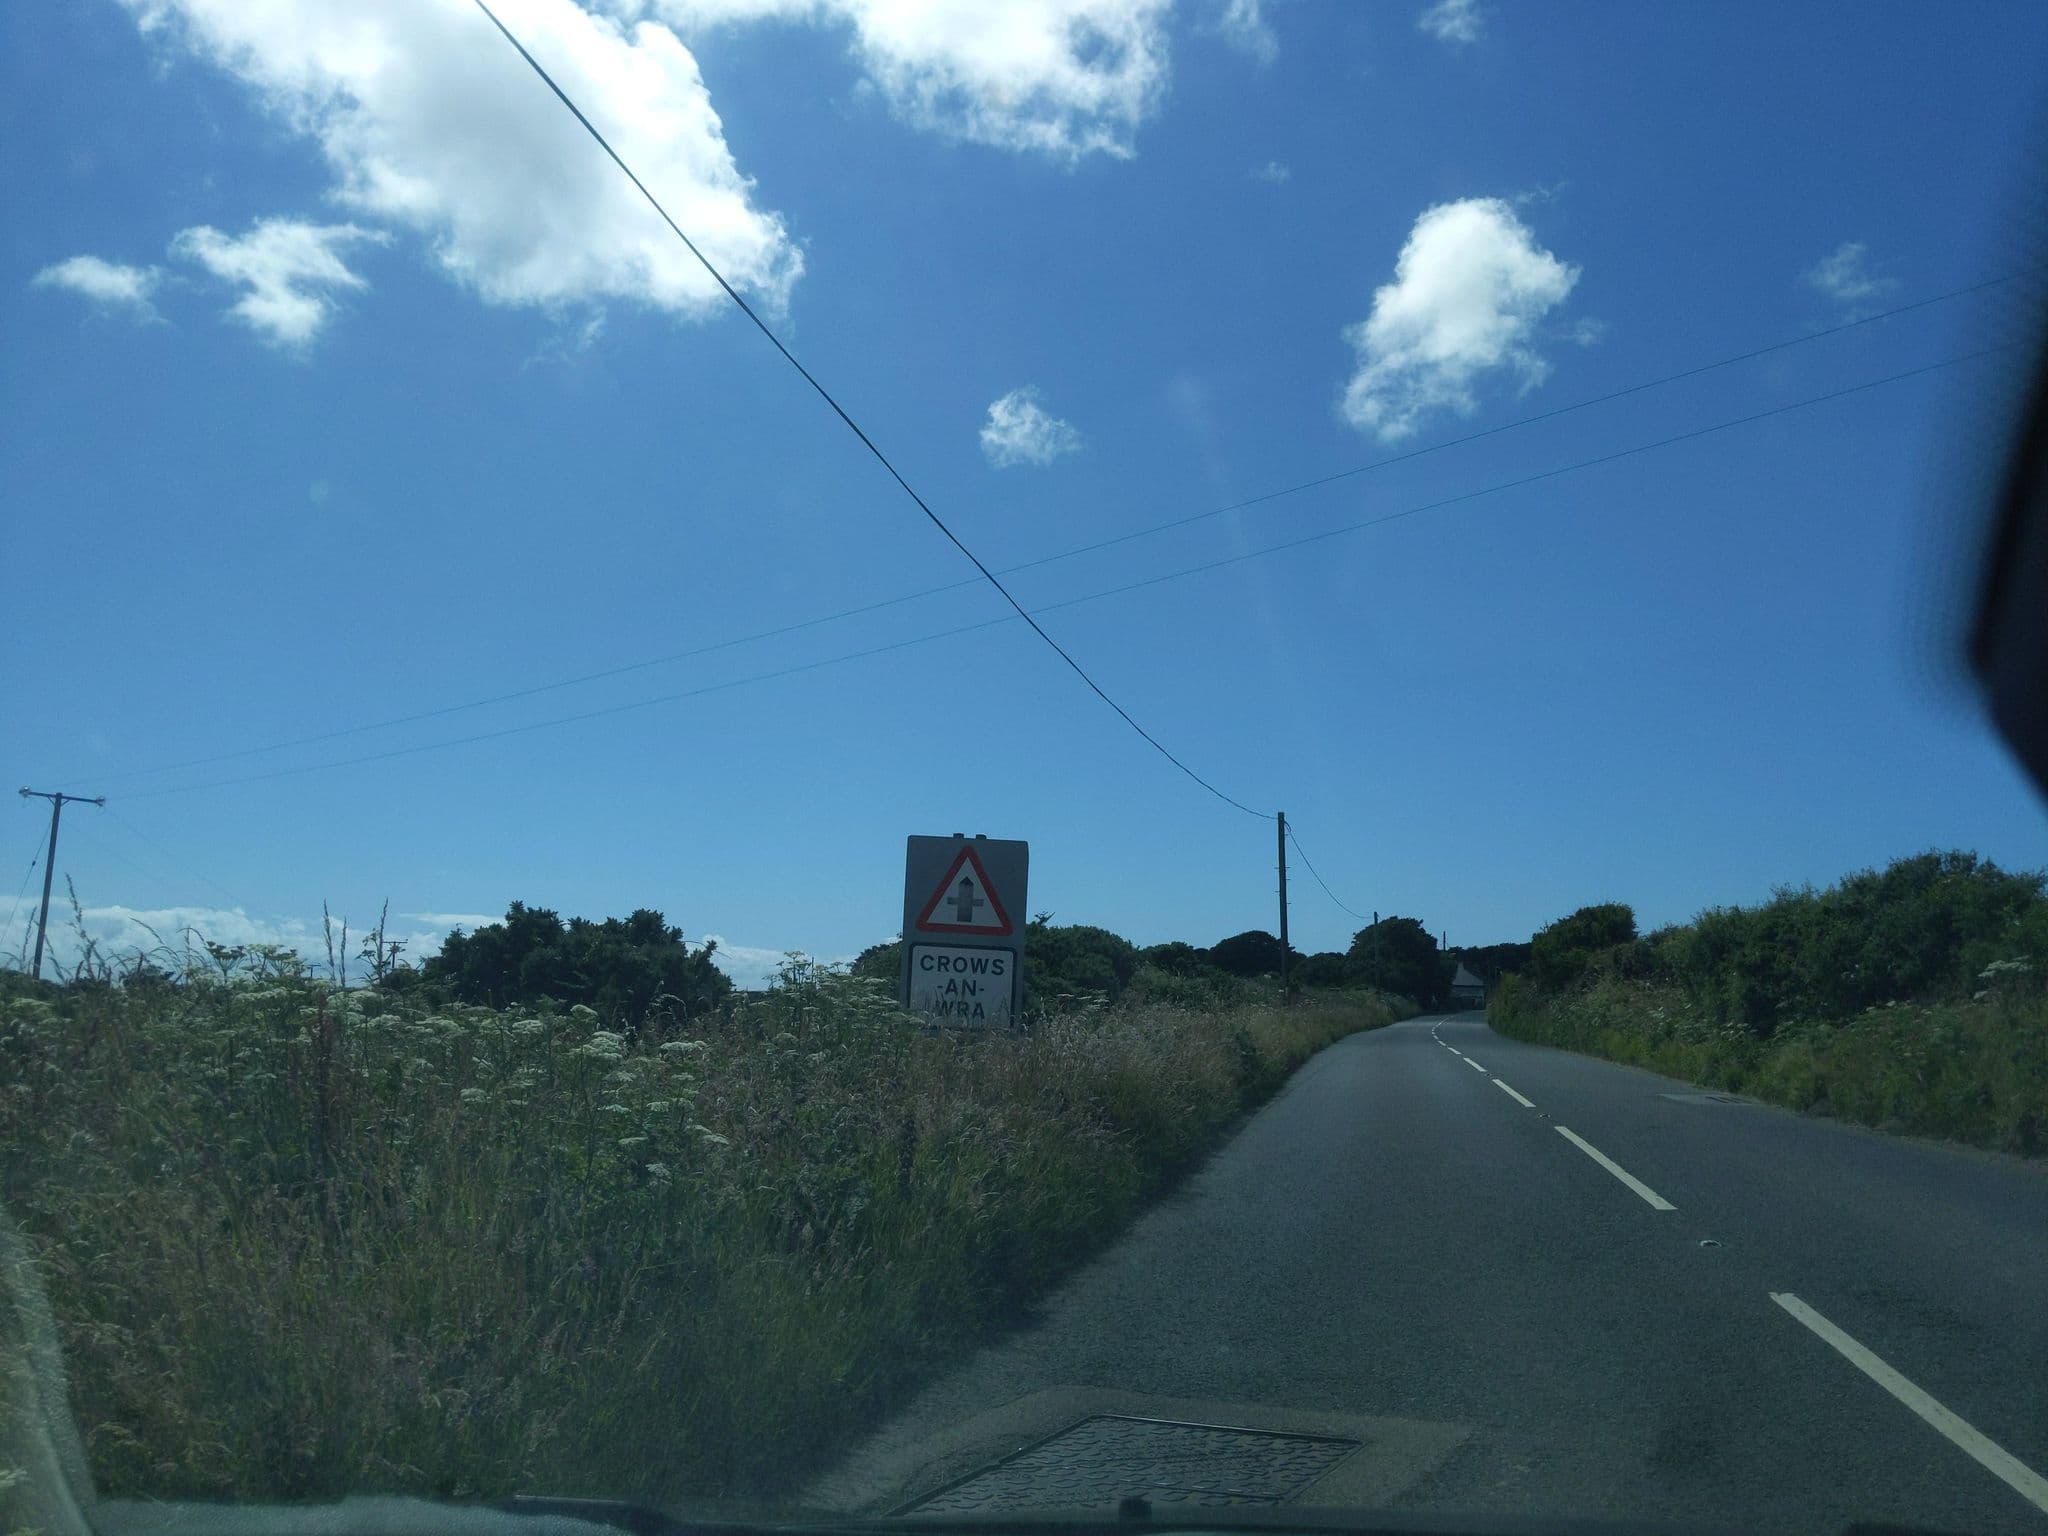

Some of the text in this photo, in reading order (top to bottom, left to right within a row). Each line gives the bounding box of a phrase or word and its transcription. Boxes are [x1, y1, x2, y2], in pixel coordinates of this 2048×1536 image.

[920, 955, 1004, 976] CROWS
[937, 978, 984, 996] -AN-
[936, 1000, 985, 1019] WRA
